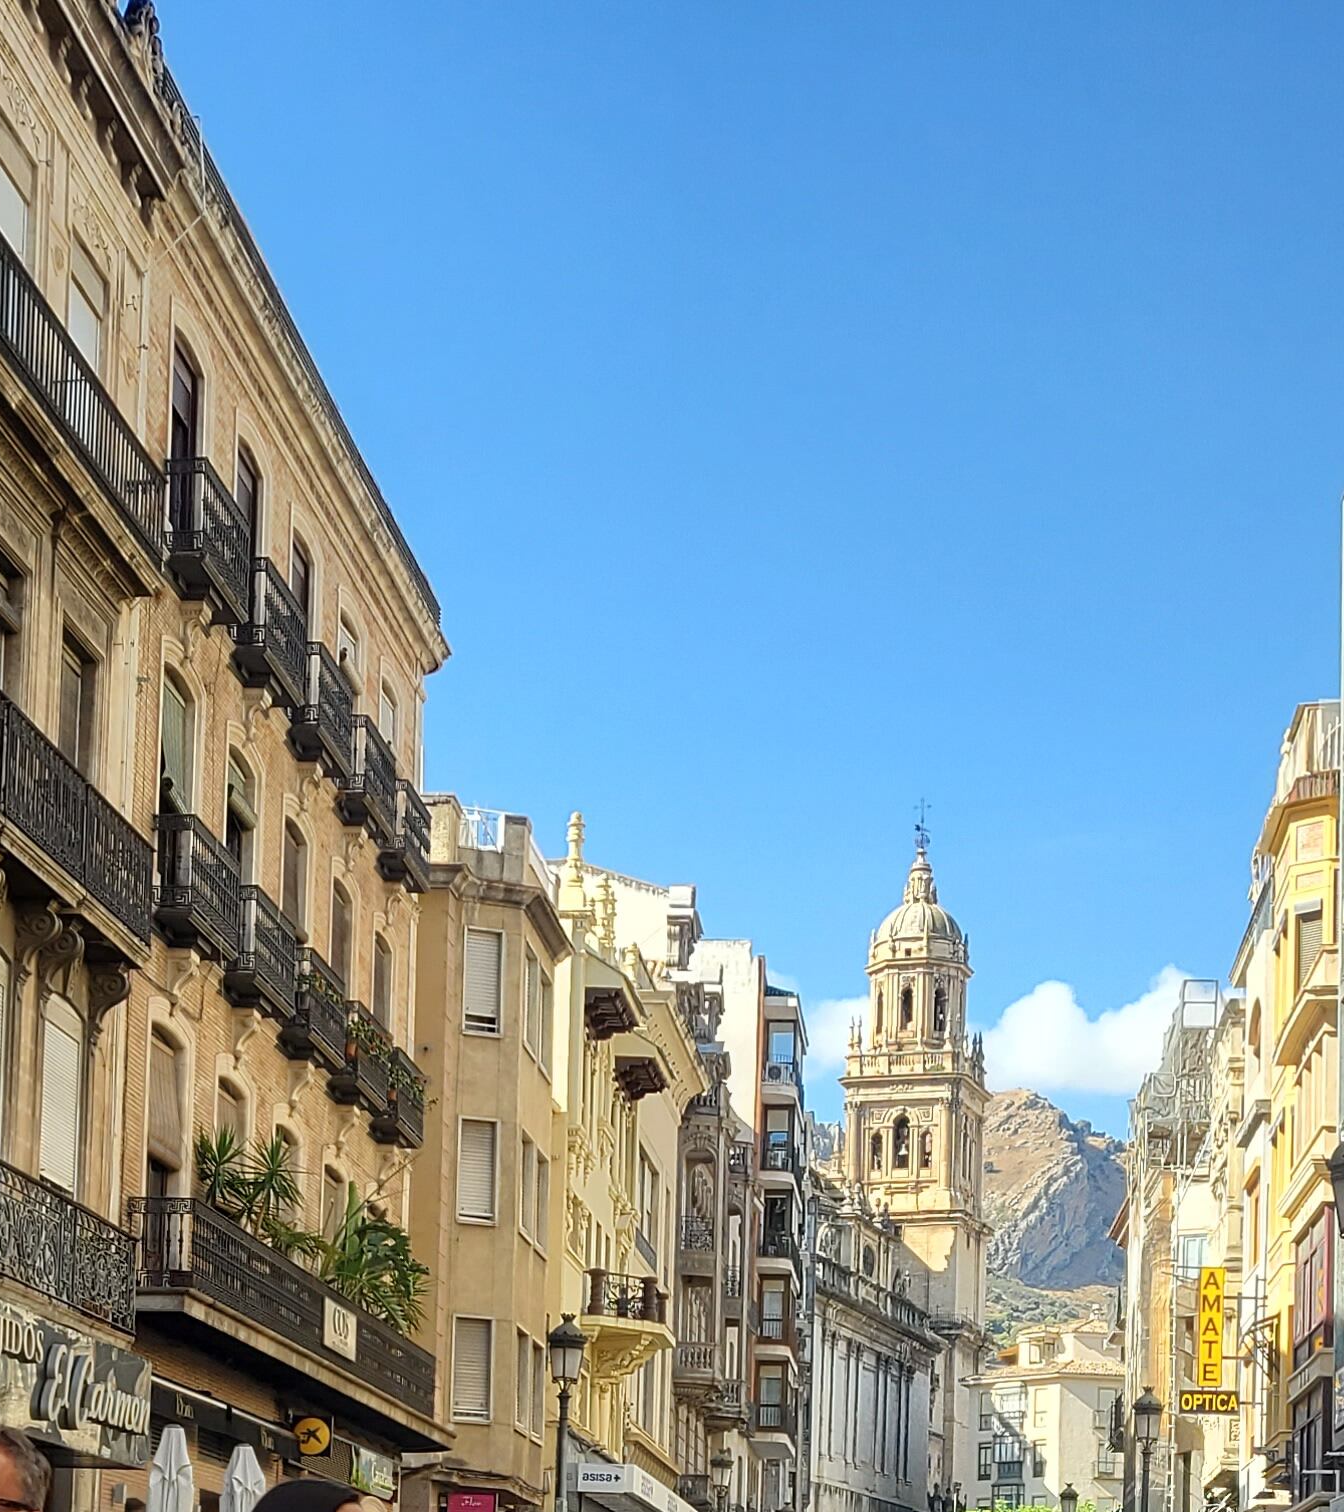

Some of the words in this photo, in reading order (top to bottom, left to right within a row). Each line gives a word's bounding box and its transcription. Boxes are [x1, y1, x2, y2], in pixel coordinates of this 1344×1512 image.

[1202, 1271, 1221, 1382] AMATE
[46, 1343, 75, 1422] El
[73, 1353, 151, 1436] Carmen
[1181, 1394, 1238, 1411] OPTICA
